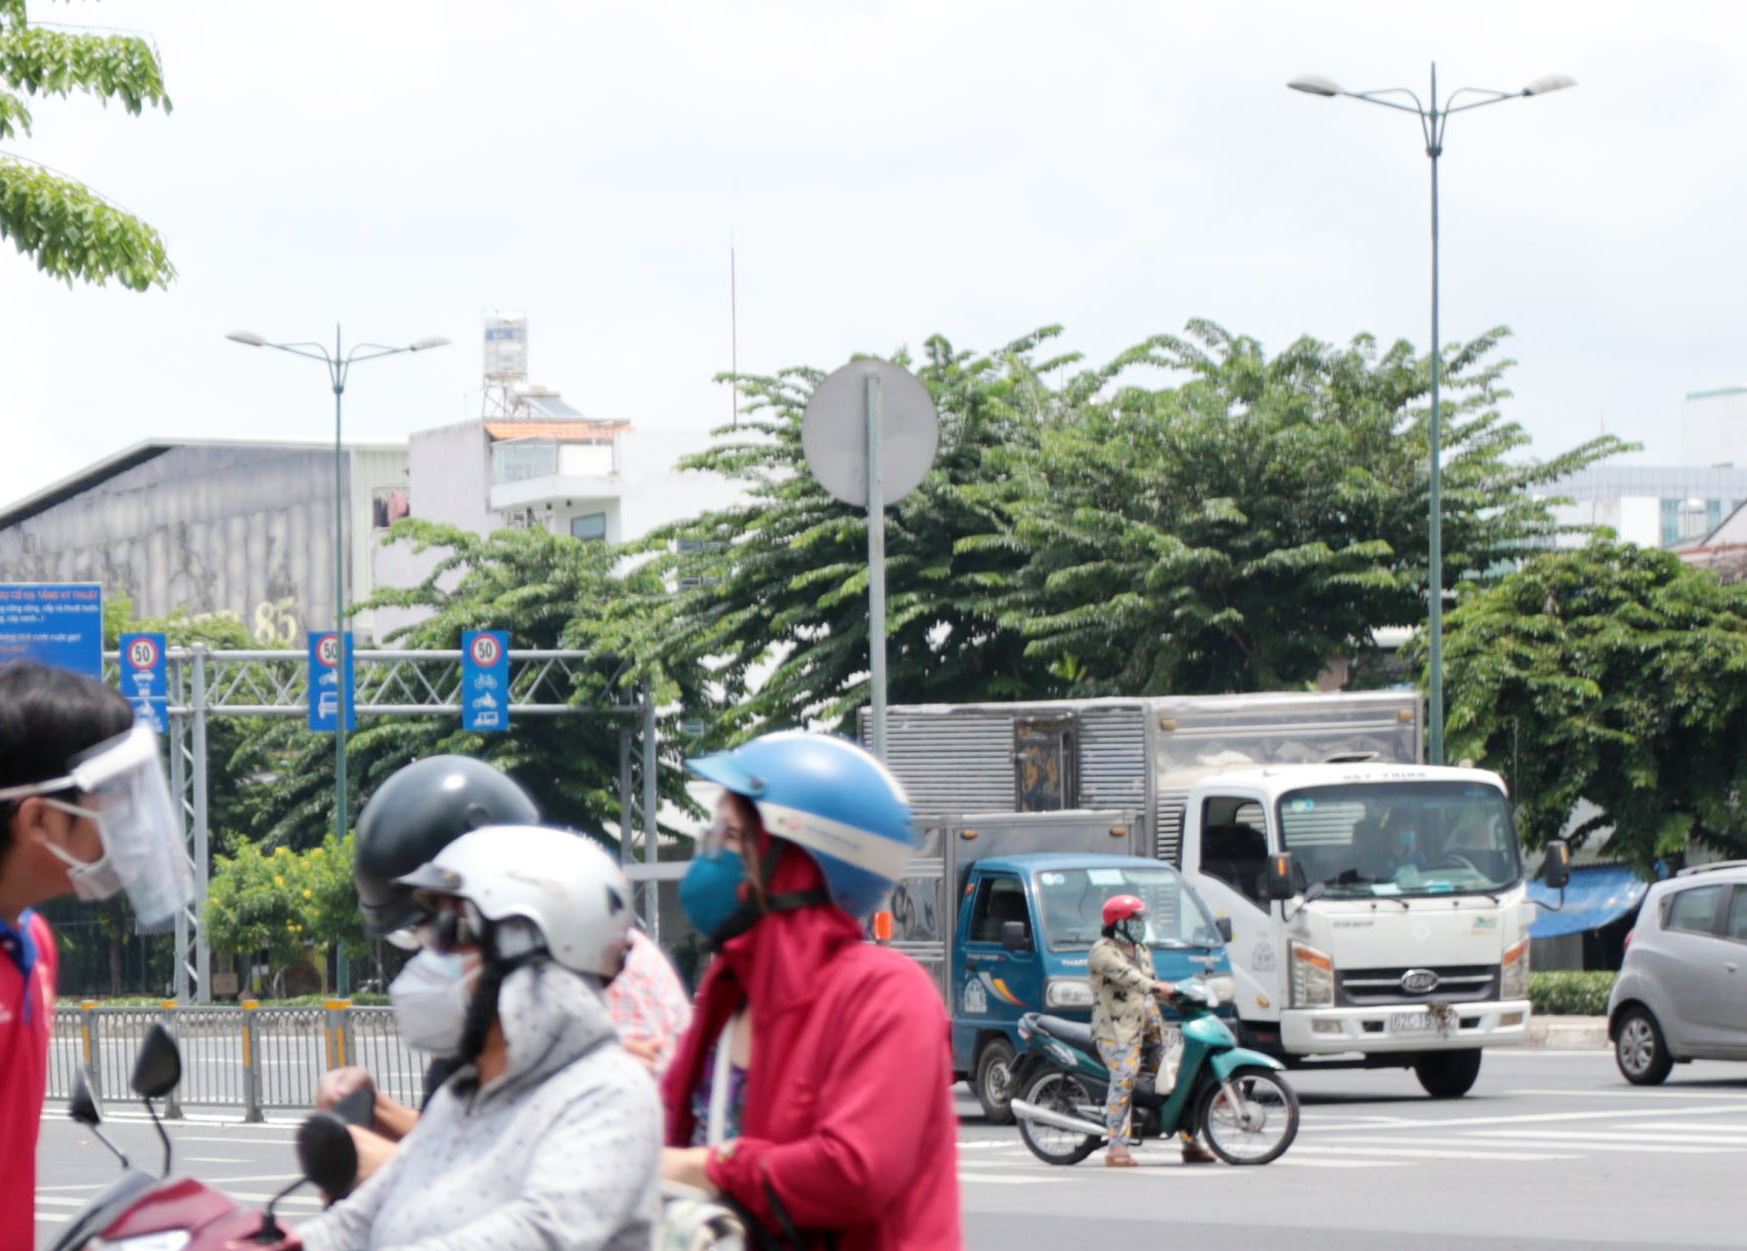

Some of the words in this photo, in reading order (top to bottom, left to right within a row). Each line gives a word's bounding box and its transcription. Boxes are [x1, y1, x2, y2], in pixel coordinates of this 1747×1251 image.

[254, 596, 297, 642] 85
[134, 645, 150, 662] 50
[323, 641, 339, 658] 50
[478, 641, 493, 659] 50
